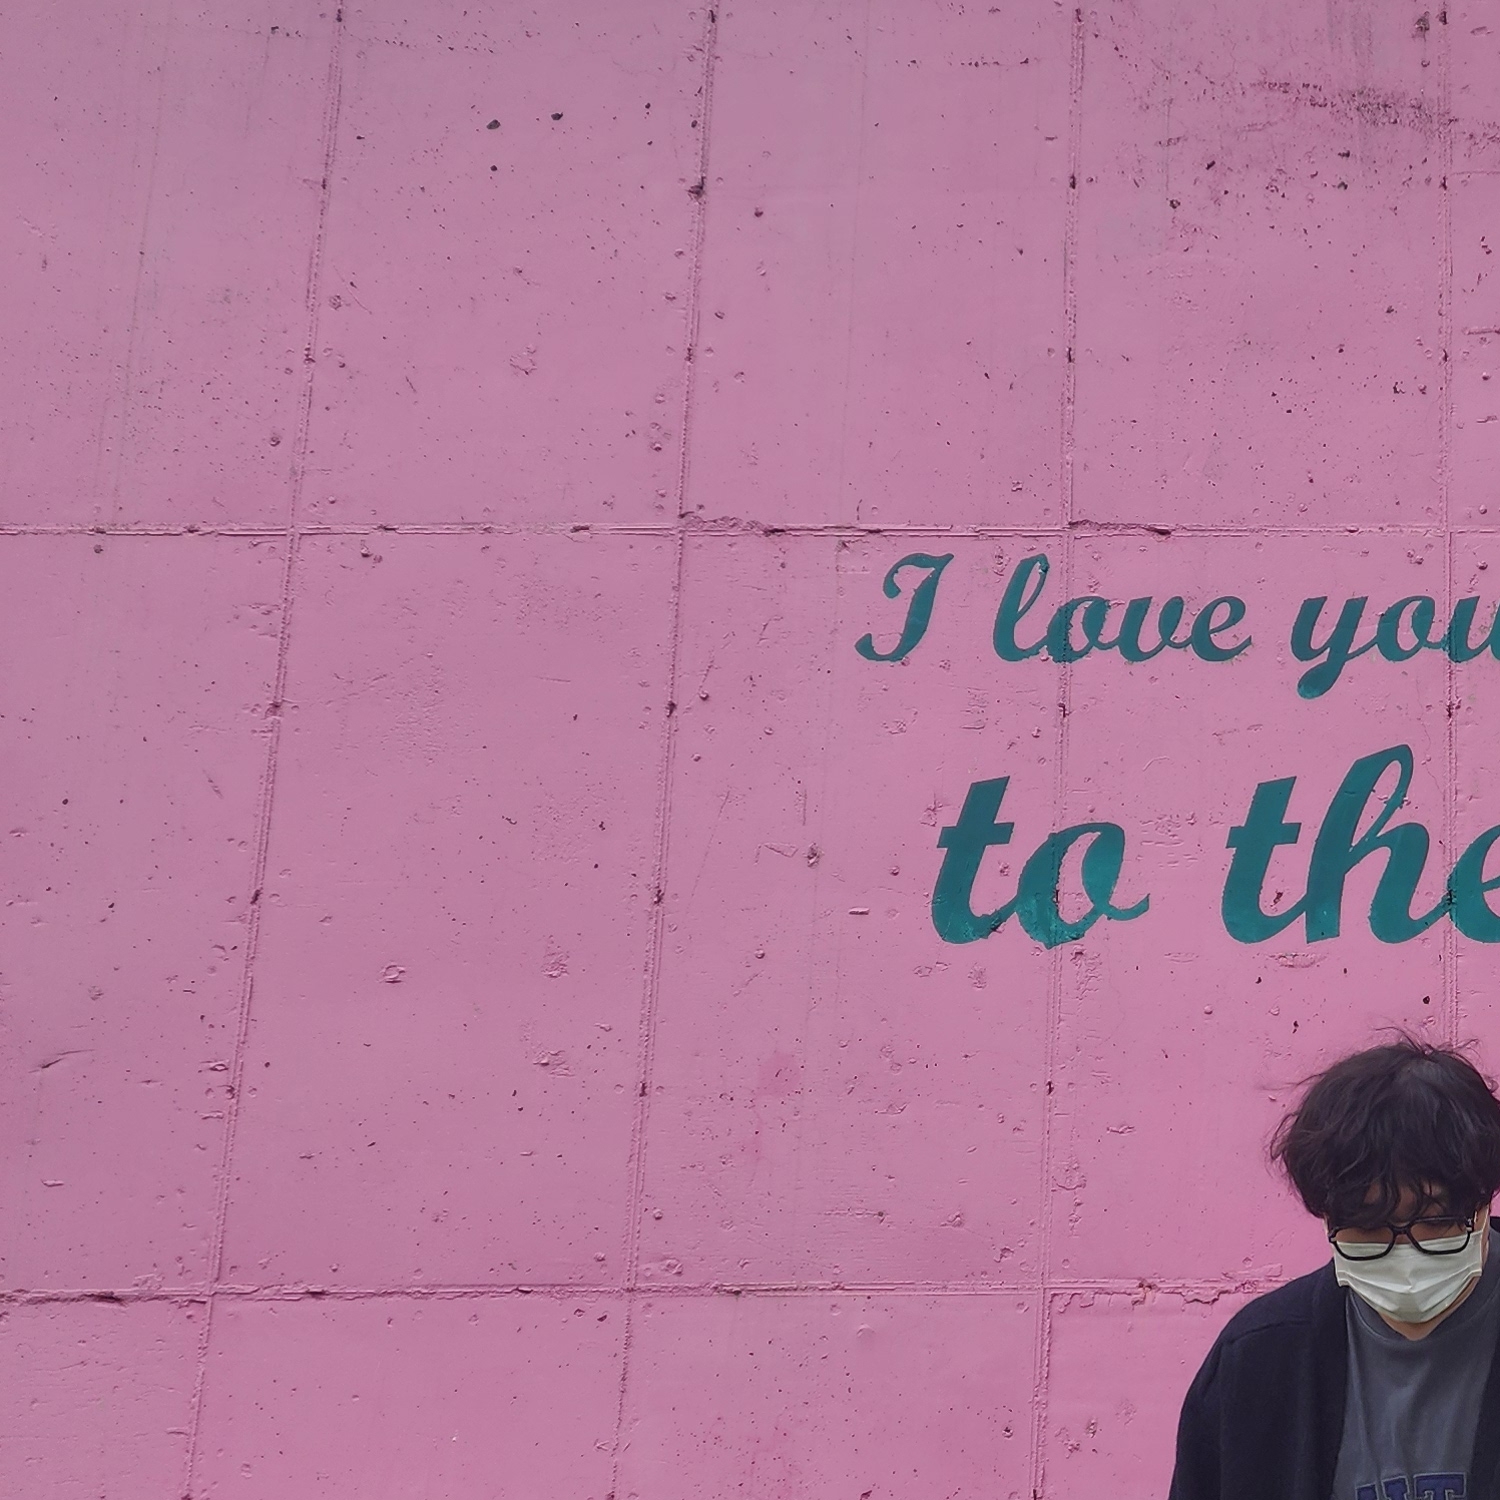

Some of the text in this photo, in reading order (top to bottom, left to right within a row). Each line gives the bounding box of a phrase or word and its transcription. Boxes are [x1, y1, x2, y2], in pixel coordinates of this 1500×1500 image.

[857, 555, 951, 663] I
[994, 555, 1245, 664] love
[932, 779, 1149, 949] to
